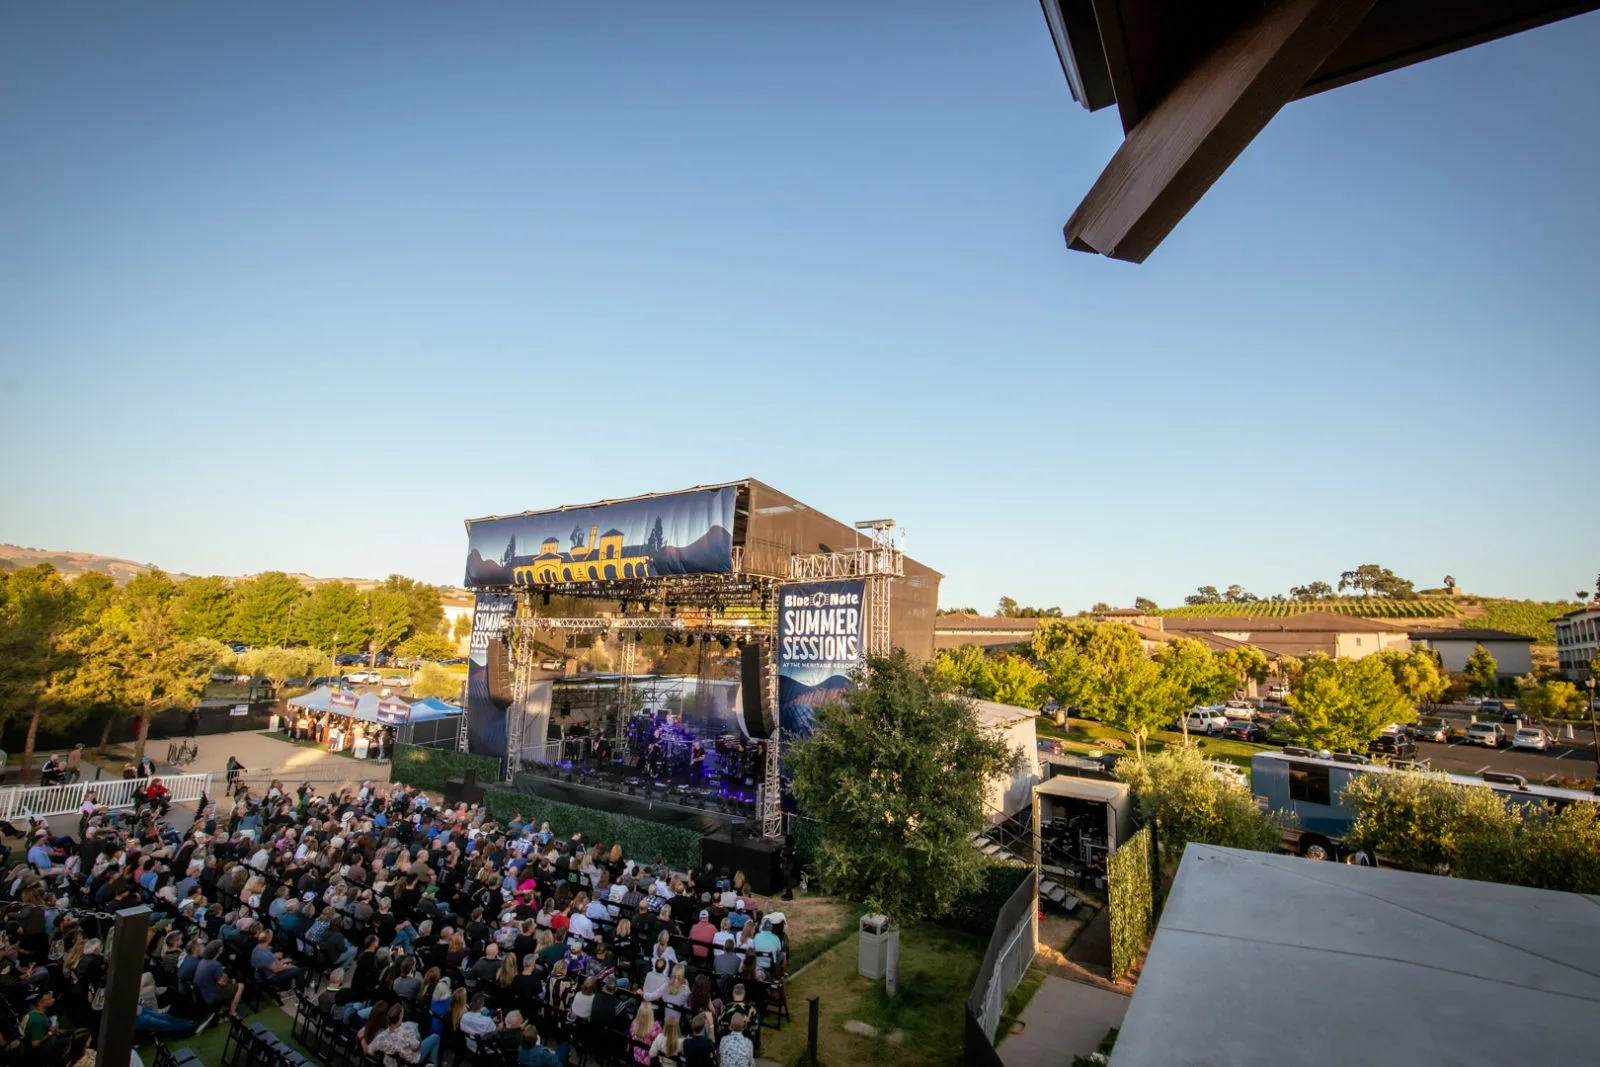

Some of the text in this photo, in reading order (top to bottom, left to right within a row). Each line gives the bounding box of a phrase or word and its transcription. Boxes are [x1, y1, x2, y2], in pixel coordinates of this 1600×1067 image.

[784, 592, 859, 607] Blue Note
[784, 608, 858, 635] SUMMER
[782, 635, 858, 660] SESSIONS
